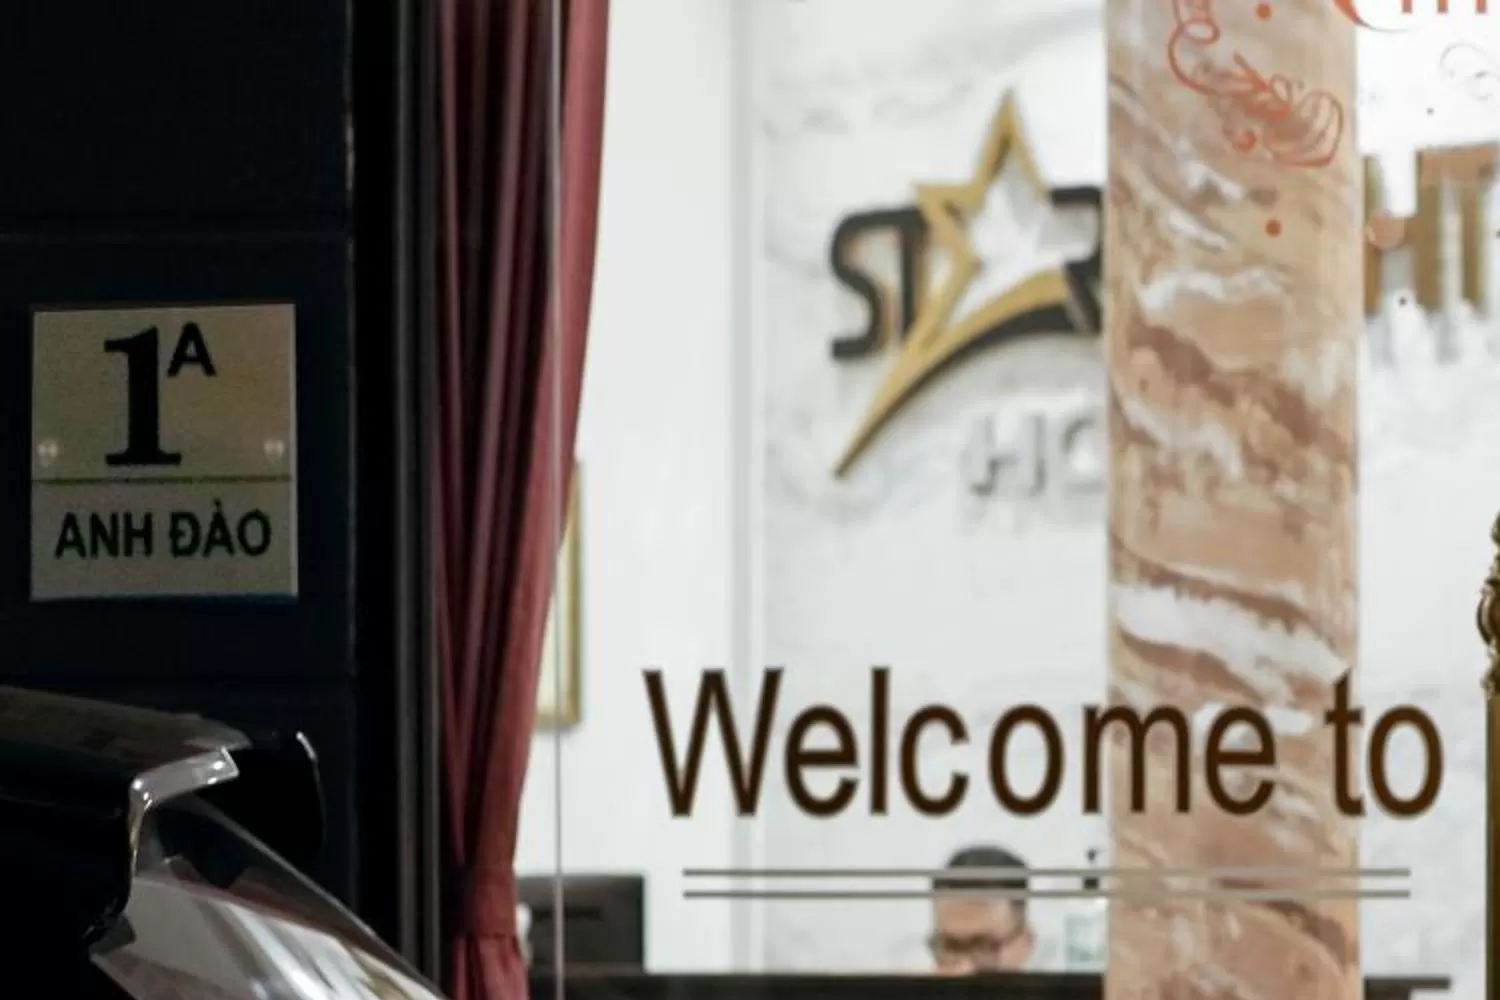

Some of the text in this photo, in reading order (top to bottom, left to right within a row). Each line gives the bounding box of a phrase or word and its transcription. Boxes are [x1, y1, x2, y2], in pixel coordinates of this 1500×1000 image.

[104, 322, 216, 466] 1A
[55, 498, 271, 558] ANH ĐÀO
[642, 666, 1444, 818] Welcome to
